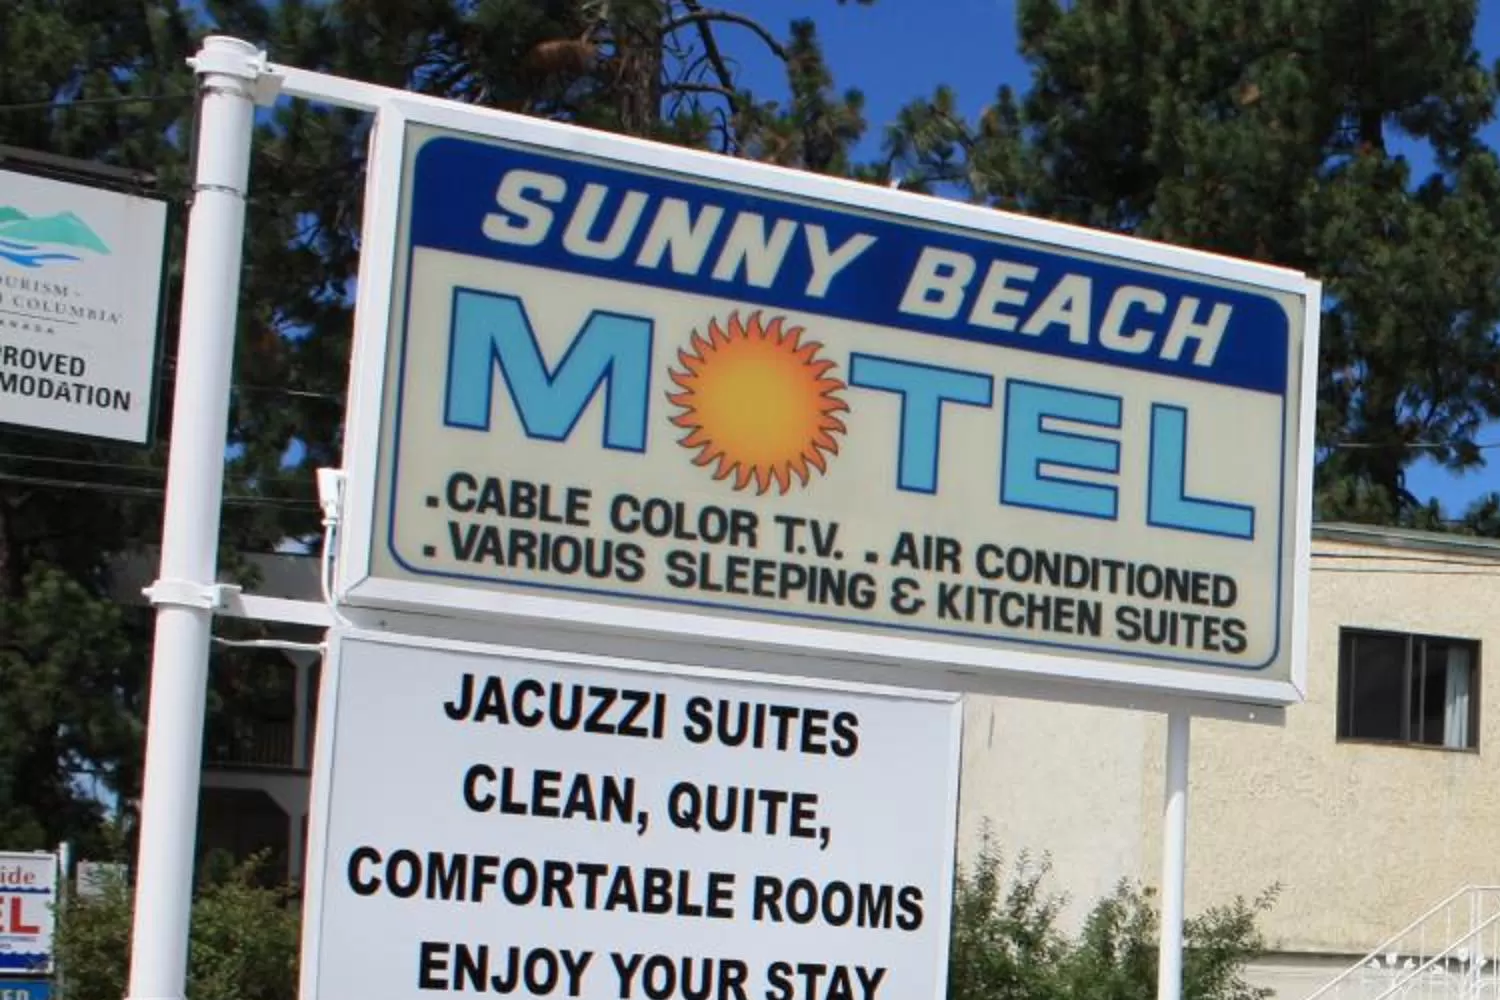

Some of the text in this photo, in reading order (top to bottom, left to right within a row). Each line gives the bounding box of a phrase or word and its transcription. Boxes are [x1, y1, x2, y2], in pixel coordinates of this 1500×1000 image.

[481, 169, 1233, 367] SUNNY BEACH
[13, 296, 119, 325] COLUMBIA
[0, 344, 86, 378] ROVED
[446, 471, 844, 560] CABLE COLOR T.V.
[447, 520, 1248, 655] VARIOUS SLEEPING & KITCHEN SUITES
[890, 531, 1238, 608] AIR CONDITIONED
[444, 673, 859, 757] JACUZZI SUITES
[463, 763, 831, 850] CLEAN, QUITE,
[347, 846, 924, 931] COMFORTABLE ROOMS
[418, 941, 593, 997] ENJOY
